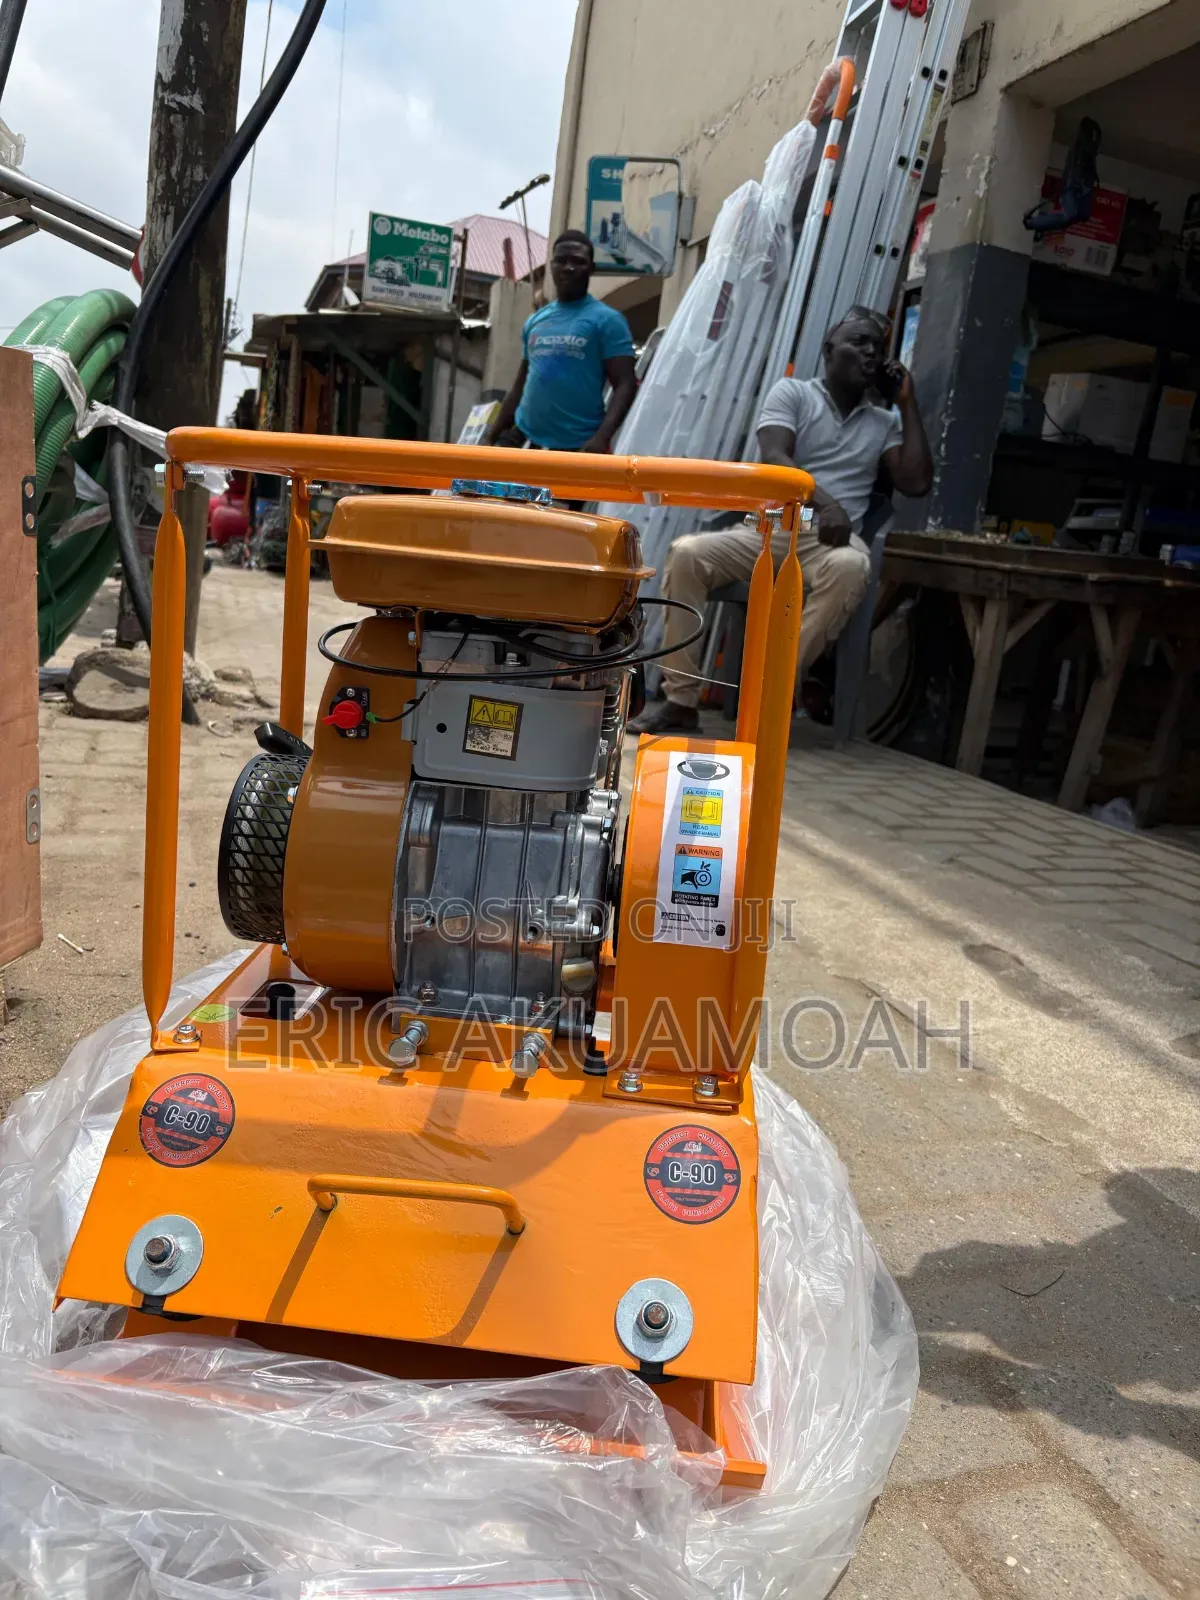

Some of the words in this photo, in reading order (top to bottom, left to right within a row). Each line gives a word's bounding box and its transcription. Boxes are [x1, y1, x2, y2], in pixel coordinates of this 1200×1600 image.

[392, 221, 449, 245] Metabo
[687, 847, 720, 857] WARNING
[165, 1079, 200, 1094] PERFECT
[206, 1083, 229, 1112] QUALITY
[163, 1104, 211, 1134] C-90
[657, 1130, 690, 1152] PERFECT
[697, 1132, 729, 1158] QUALITY
[668, 1161, 717, 1186] C-90
[656, 1189, 678, 1212] PLATE
[681, 1195, 726, 1216] COMPACTOR
